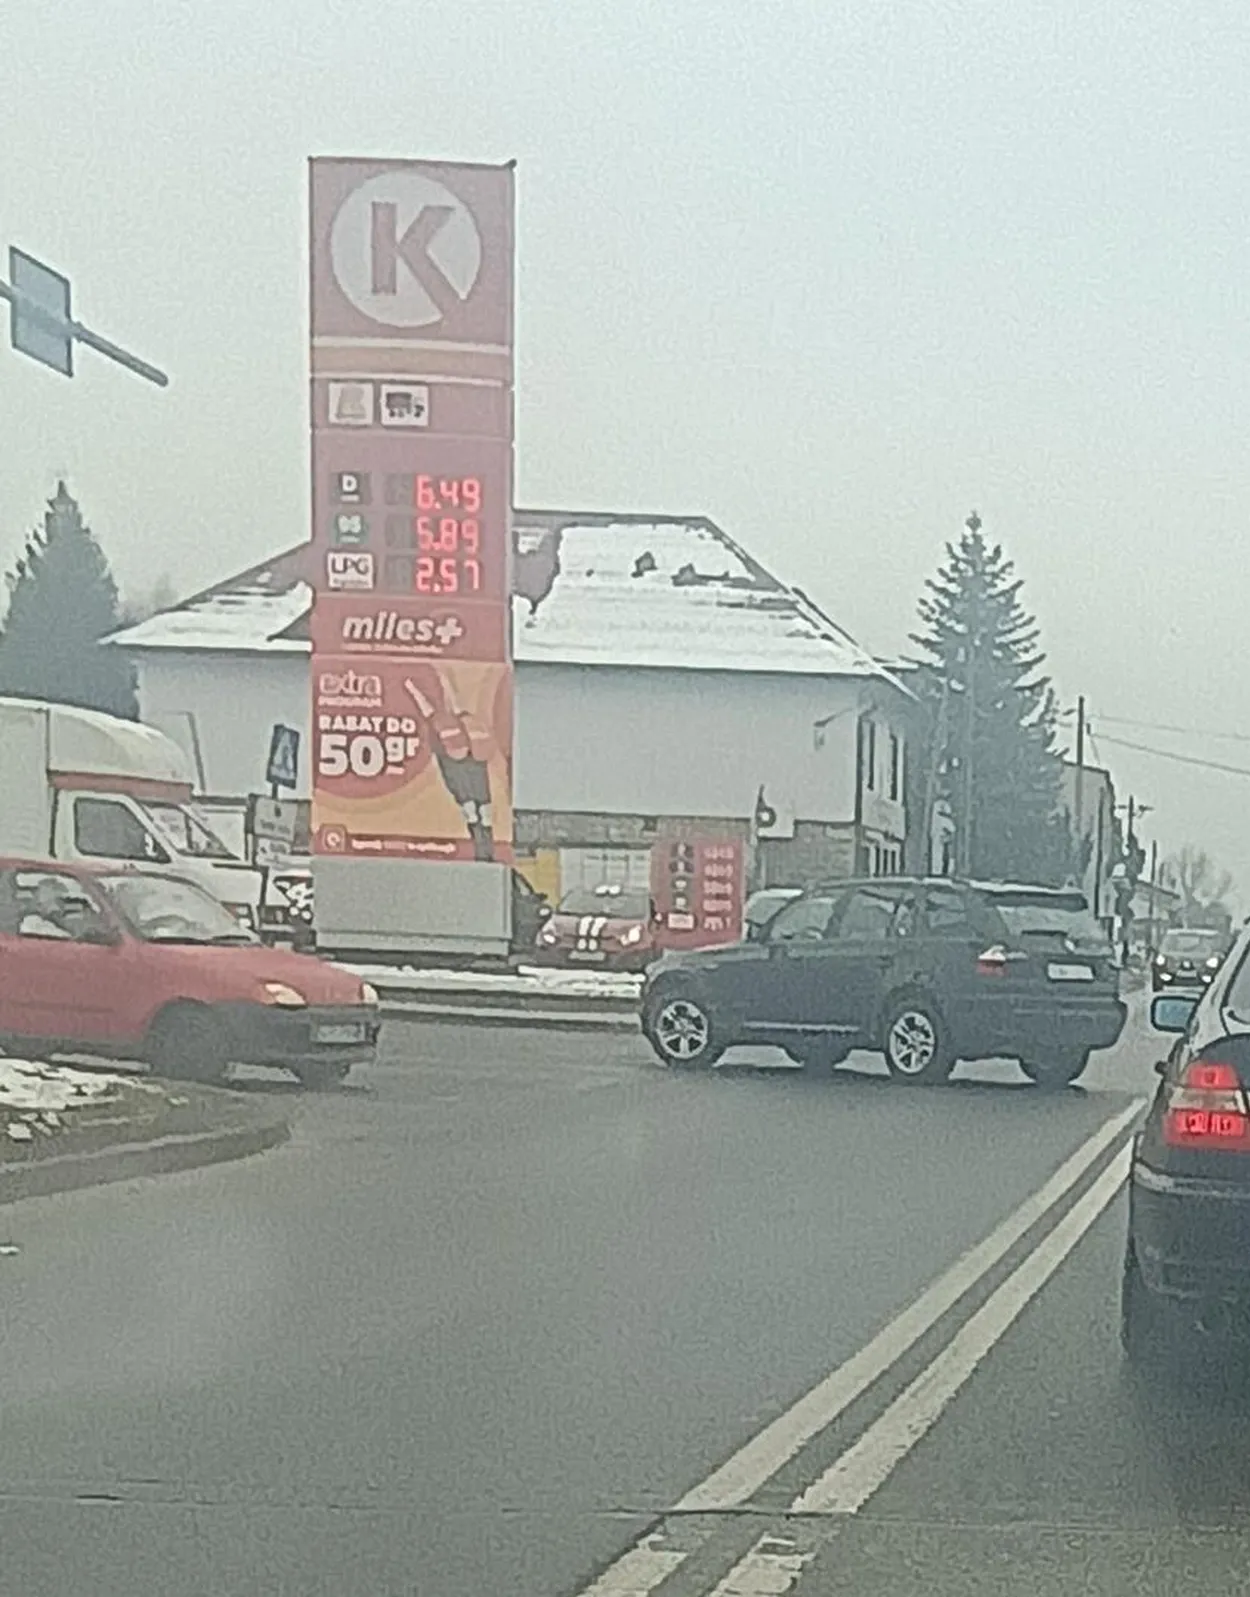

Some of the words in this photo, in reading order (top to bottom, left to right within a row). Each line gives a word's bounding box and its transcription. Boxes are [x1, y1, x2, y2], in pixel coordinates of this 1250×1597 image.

[370, 200, 462, 318] K
[342, 474, 358, 493] D
[416, 474, 481, 513] 6.49
[416, 557, 480, 593] 2.57
[342, 611, 463, 645] miles+
[319, 669, 382, 696] extra
[386, 717, 417, 734] DO
